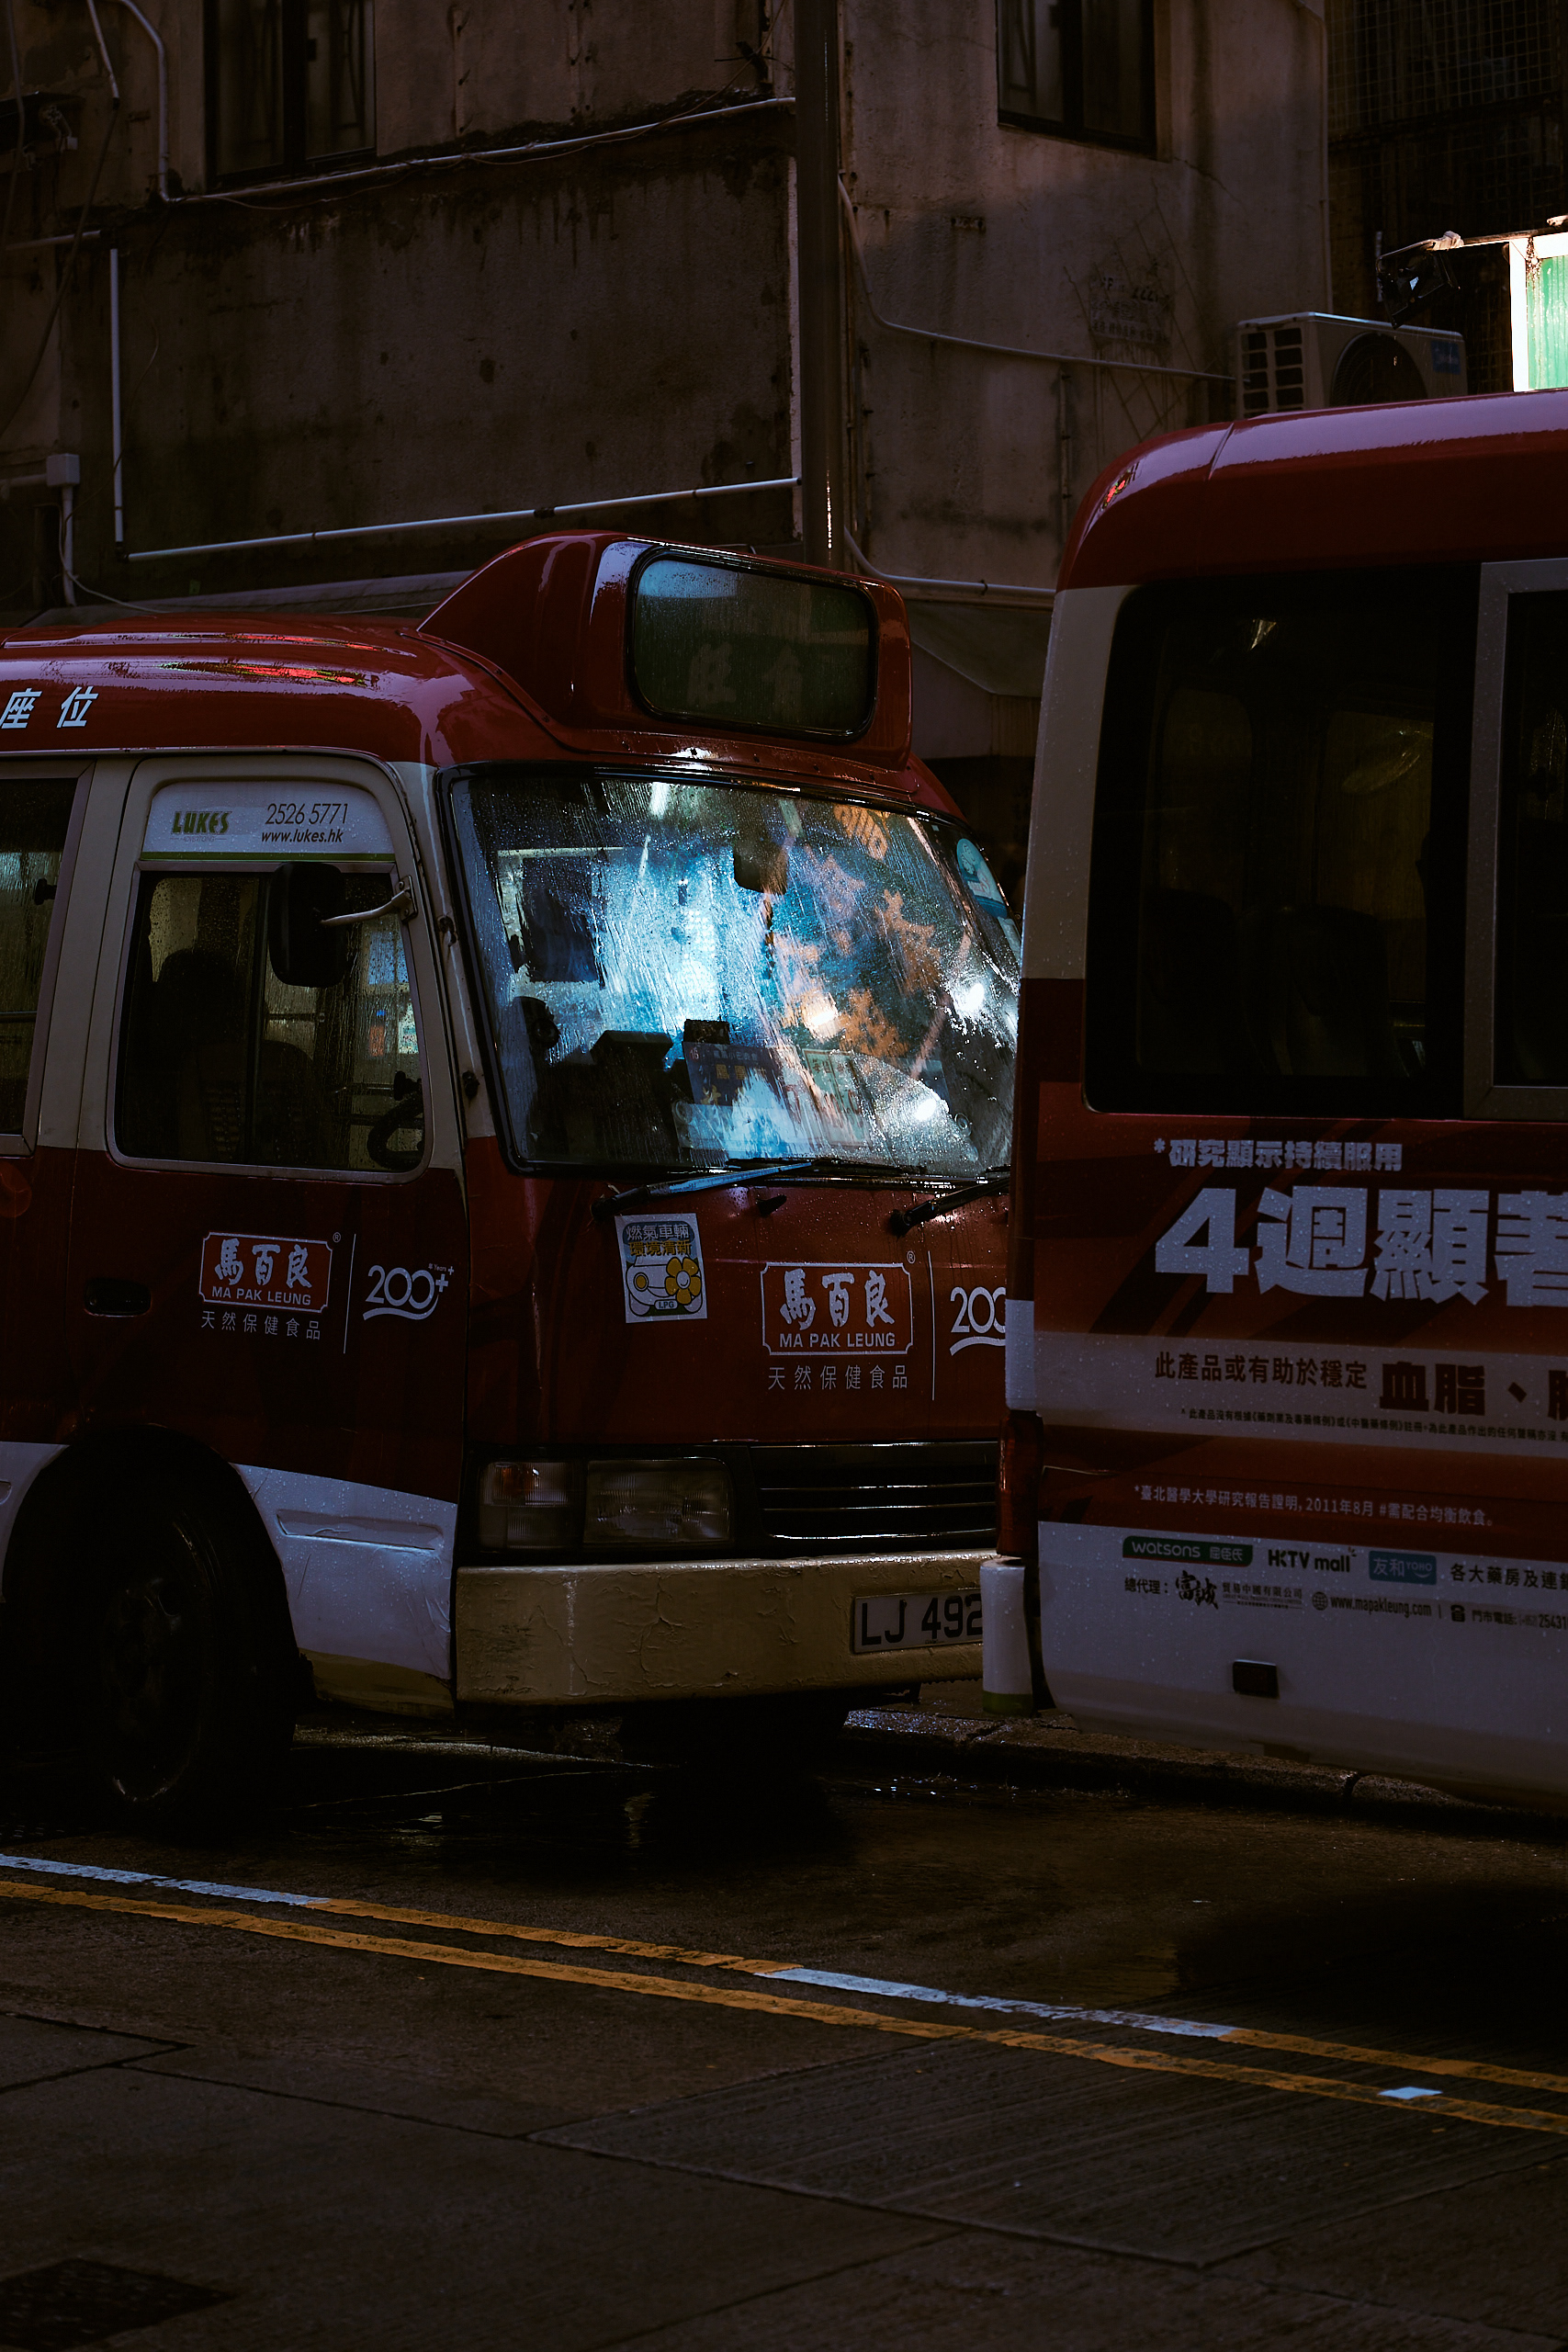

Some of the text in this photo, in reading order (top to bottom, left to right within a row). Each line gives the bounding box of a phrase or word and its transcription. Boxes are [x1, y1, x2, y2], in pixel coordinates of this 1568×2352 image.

[0, 686, 98, 729] 座位
[172, 811, 231, 835] LUKES
[265, 803, 349, 825] 2526 5771
[262, 829, 344, 842] www.lukes.hk
[214, 1237, 313, 1290] 馬百良
[211, 1285, 312, 1306] MA PAK LEUNG
[658, 1301, 675, 1309] LPG
[779, 1268, 896, 1330] 馬百良
[200, 1309, 321, 1340] 天然保健食品
[779, 1332, 896, 1349] MA PAK LEUNG
[768, 1364, 909, 1391] 天然保健食品
[1155, 1351, 1369, 1390] 此產品或有助於穩定
[1132, 1541, 1244, 1562] watsons 屈臣氏
[1372, 1556, 1434, 1578] 友和 YOHO
[1330, 1596, 1432, 1618] www.mapakleung.com
[862, 1600, 908, 1646] LJ
